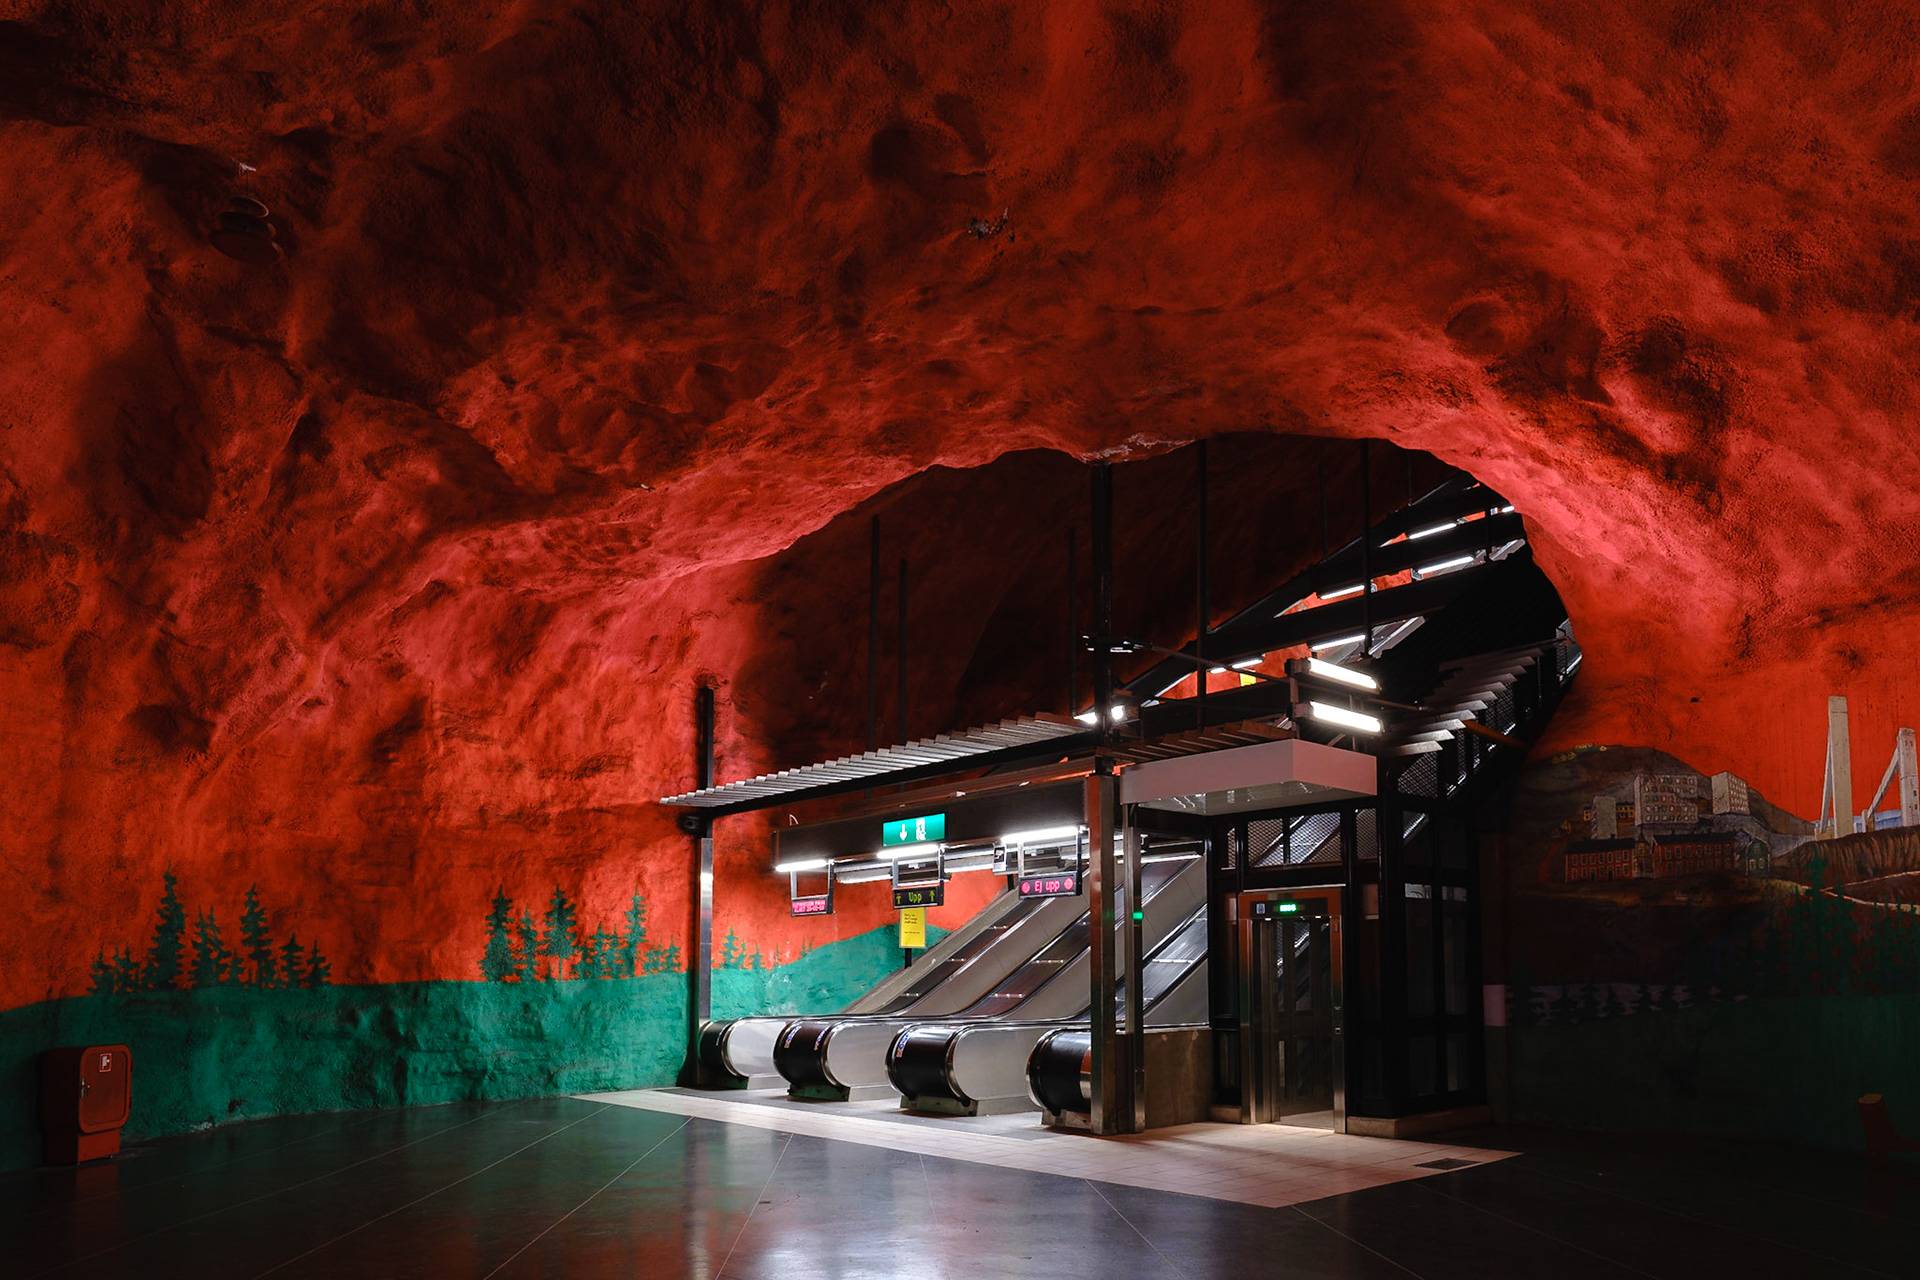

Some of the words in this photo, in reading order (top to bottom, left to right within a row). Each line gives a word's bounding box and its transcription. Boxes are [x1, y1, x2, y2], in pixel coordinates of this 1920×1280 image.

[1034, 880, 1043, 893] Ej
[1045, 880, 1060, 892] upp
[908, 892, 922, 903] Upp
